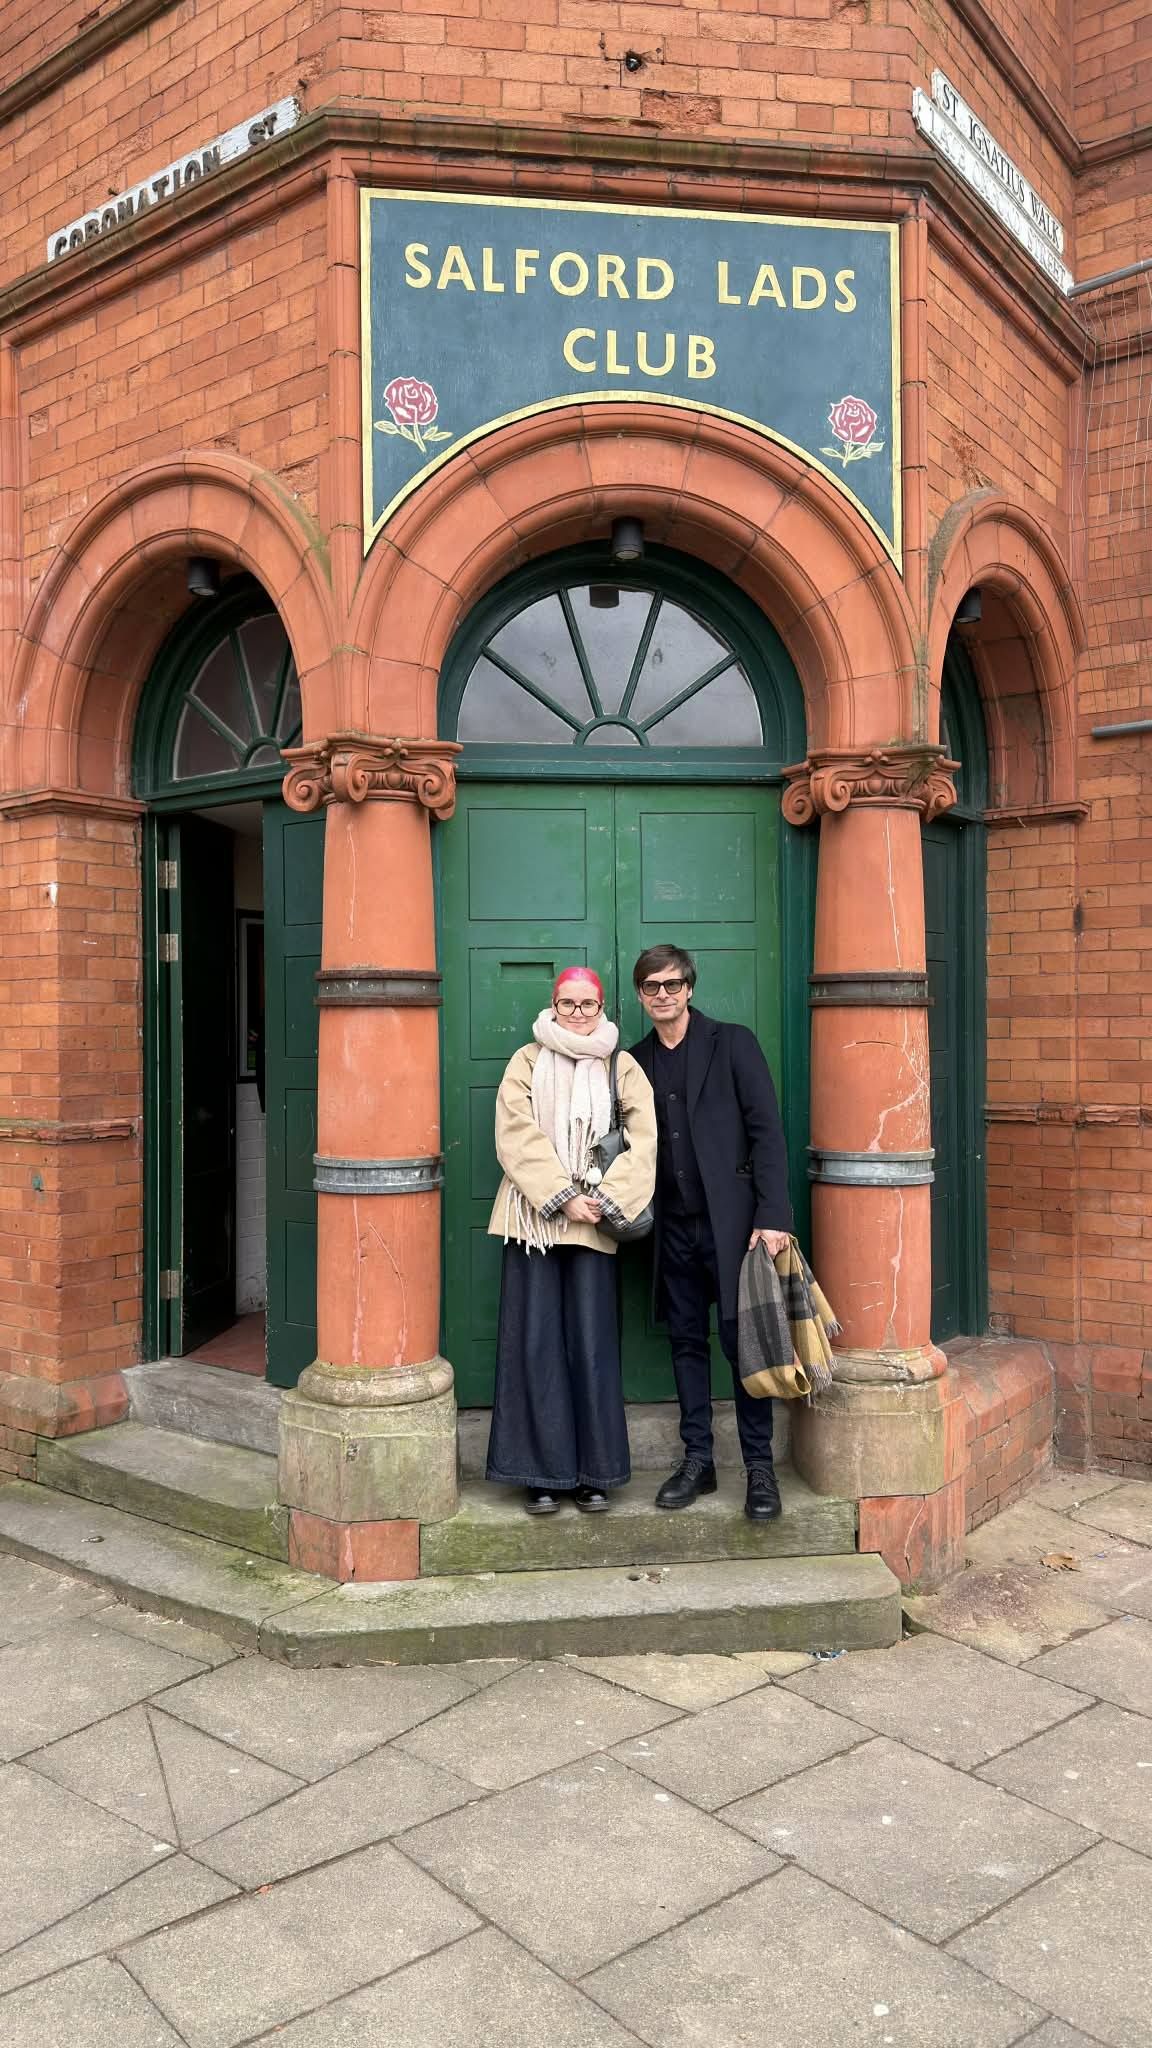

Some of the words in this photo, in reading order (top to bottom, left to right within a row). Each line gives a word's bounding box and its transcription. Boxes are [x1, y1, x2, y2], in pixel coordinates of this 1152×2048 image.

[247, 112, 278, 147] ST
[943, 83, 959, 120] ST
[968, 115, 1025, 203] IGNATIUS
[1029, 191, 1060, 249] WALK
[404, 242, 675, 301] SALFORD
[717, 260, 857, 313] LADS
[1027, 226, 1065, 289] STREET
[563, 327, 717, 379] CLUB
